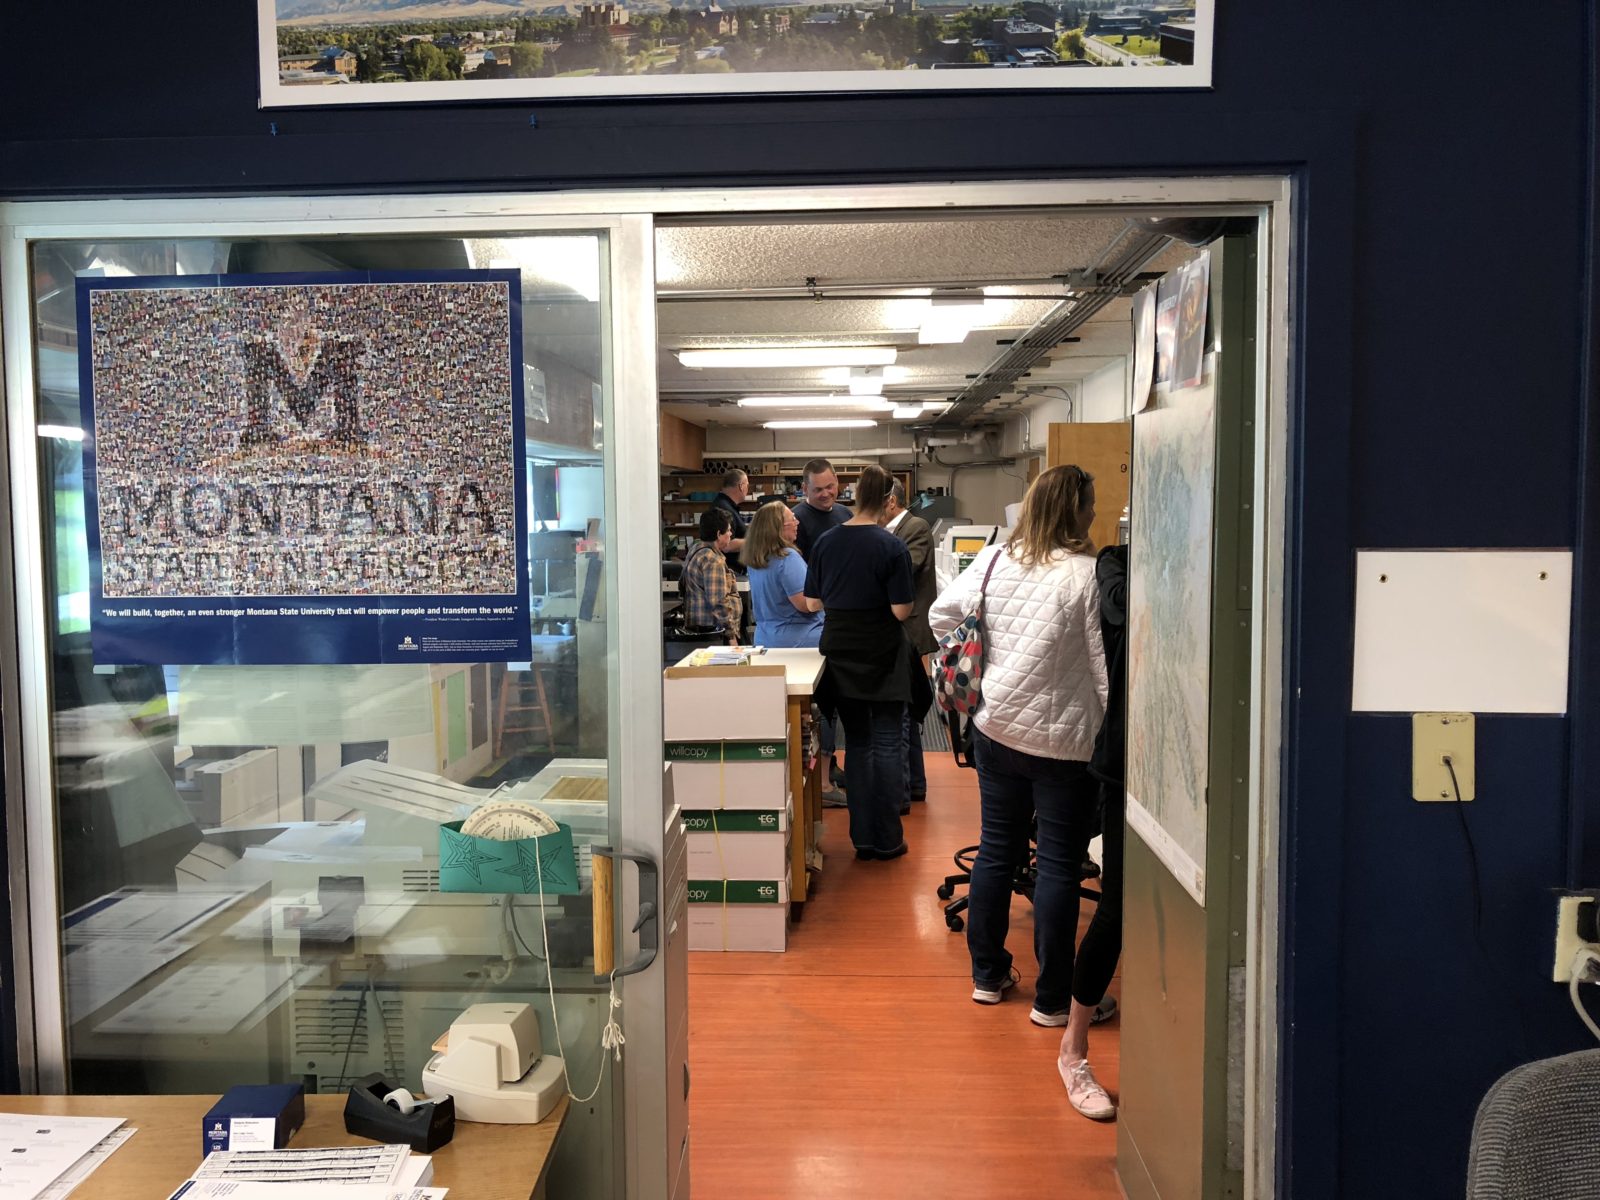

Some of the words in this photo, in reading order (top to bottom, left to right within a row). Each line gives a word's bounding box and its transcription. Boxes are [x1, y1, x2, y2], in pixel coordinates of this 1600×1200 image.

[1120, 463, 1127, 473] 9
[115, 480, 500, 538] MONTANA
[118, 608, 131, 617] will
[132, 608, 153, 618] build,
[154, 609, 186, 618] together,
[187, 609, 197, 617] an
[198, 609, 215, 617] even
[216, 608, 245, 618] stronger
[246, 607, 278, 616] Montana
[279, 607, 299, 616] State
[300, 607, 335, 617] University
[337, 606, 352, 615] that
[353, 606, 366, 615] will
[367, 607, 400, 617] empower
[401, 606, 425, 616] people
[427, 606, 441, 615] and
[442, 606, 478, 615] transform
[479, 606, 492, 615] the
[670, 746, 709, 758] willcopy
